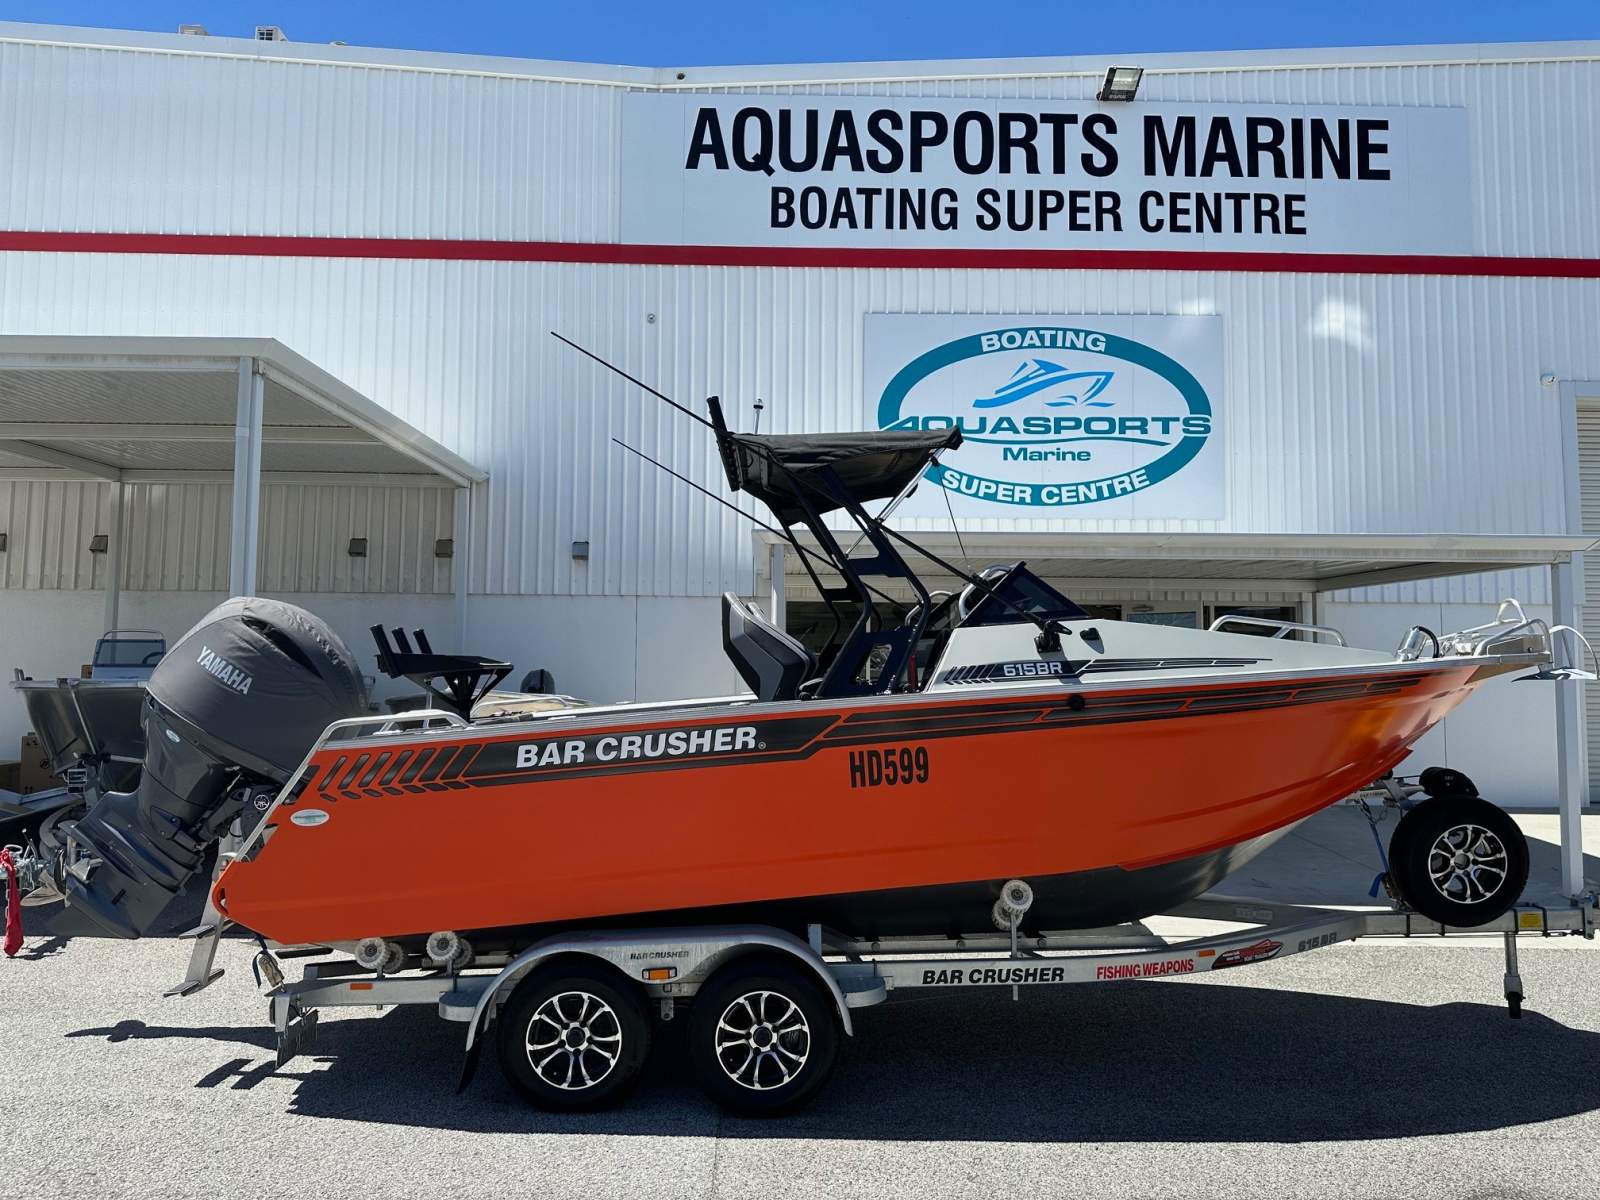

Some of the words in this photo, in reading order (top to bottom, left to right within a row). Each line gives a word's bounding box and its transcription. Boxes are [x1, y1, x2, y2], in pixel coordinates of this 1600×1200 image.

[685, 106, 1119, 178] AQUASPORTS
[1143, 115, 1391, 181] MARINE
[770, 185, 958, 231] BOATING
[975, 187, 1124, 232] SUPER
[1139, 190, 1307, 235] CENTRE
[980, 329, 1107, 352] BOATING
[884, 415, 1211, 436] AQUASPORTS
[1003, 447, 1091, 462] Marine
[942, 469, 1032, 503] SUPER
[1040, 469, 1150, 504] CENTRE
[196, 646, 253, 695] YAMAHA
[1003, 662, 1063, 676] 615BR
[516, 742, 586, 768] BAR
[595, 726, 757, 761] CRUSHER
[849, 746, 929, 788] HD599
[922, 969, 963, 985] BAR
[968, 967, 1065, 984] CRUSHER
[1096, 964, 1141, 980] FISHING
[1142, 959, 1194, 975] WEAPONS
